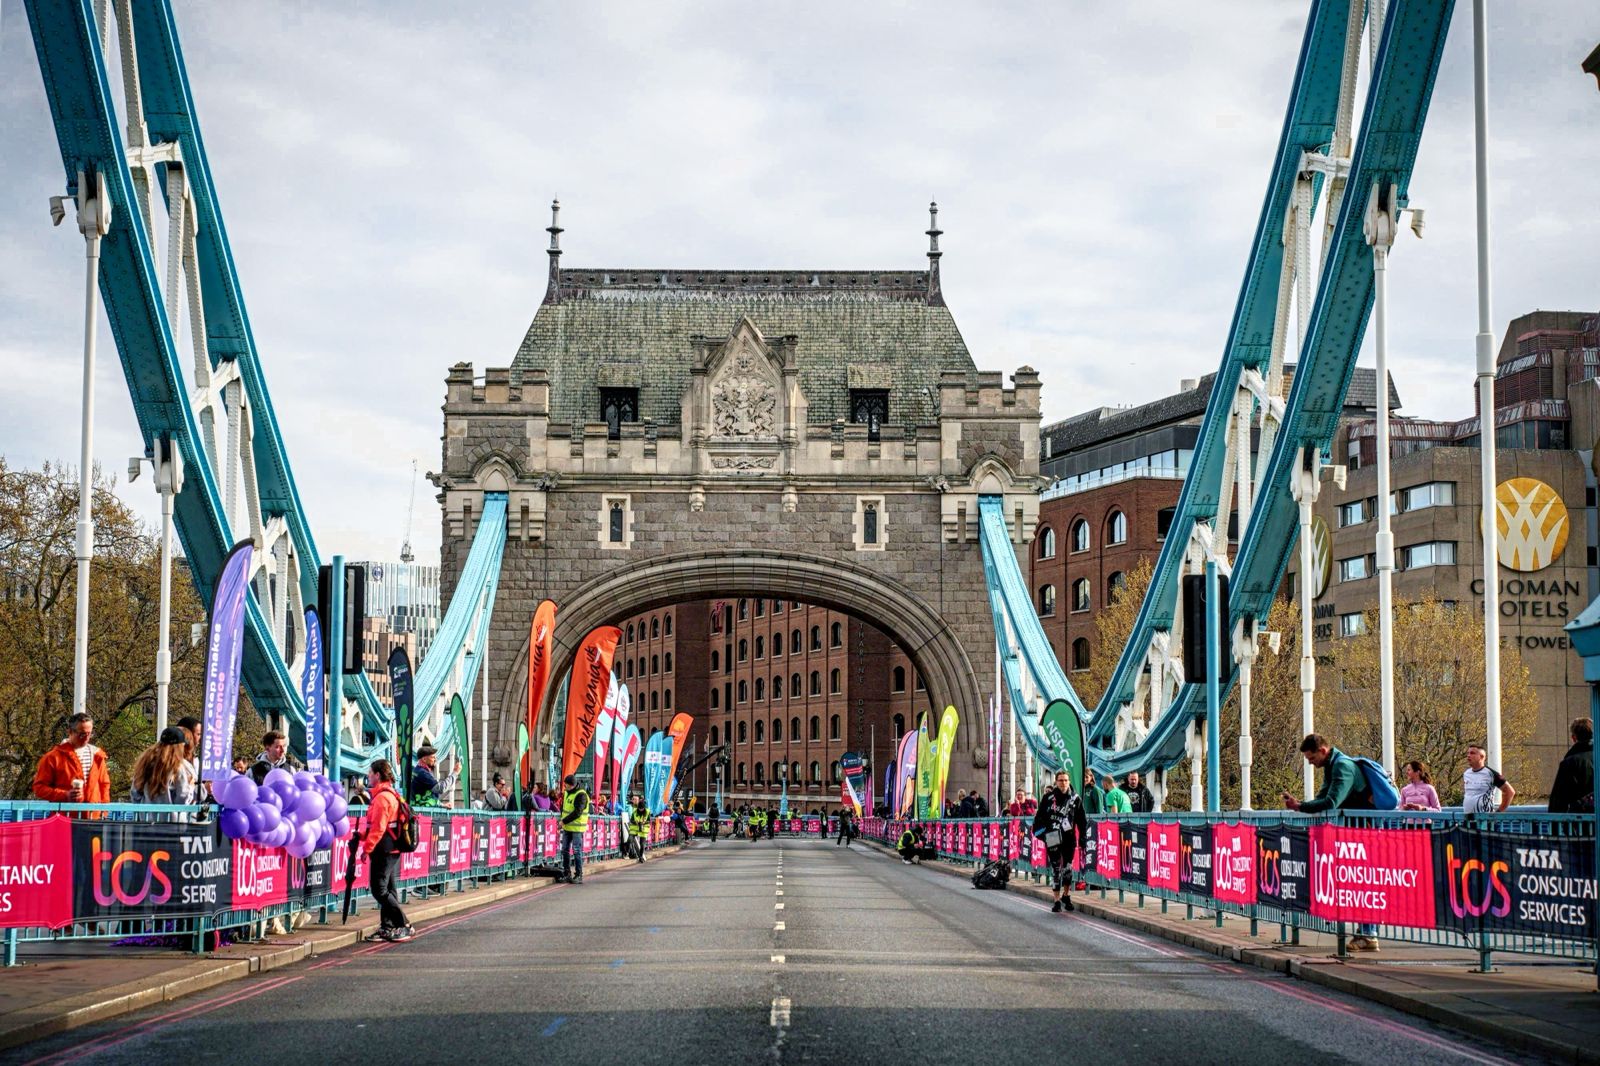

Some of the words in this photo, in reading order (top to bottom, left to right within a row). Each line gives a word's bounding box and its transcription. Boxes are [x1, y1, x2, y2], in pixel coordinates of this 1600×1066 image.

[1470, 579, 1580, 596] OMAN
[1482, 600, 1569, 618] OTELS
[210, 623, 222, 678] makes
[1516, 636, 1575, 649] TOWE
[213, 671, 225, 758] difference
[573, 661, 602, 760] Leukaemia
[214, 760, 221, 771] a
[1046, 720, 1074, 772] NSPCC
[0, 864, 54, 885] TANCY
[92, 837, 172, 907] tcs
[238, 838, 257, 896] tcs
[1181, 835, 1192, 883] tcs
[1215, 837, 1231, 890] tcs
[1260, 838, 1279, 896] tcs
[1314, 840, 1334, 907] tcs
[1335, 841, 1367, 860] TATA
[1516, 848, 1562, 869] TATA
[1335, 865, 1418, 888] CONSULTANCY
[1336, 889, 1387, 910] SERVICES
[1447, 843, 1511, 918] tcs
[1520, 900, 1586, 926] SERVICES
